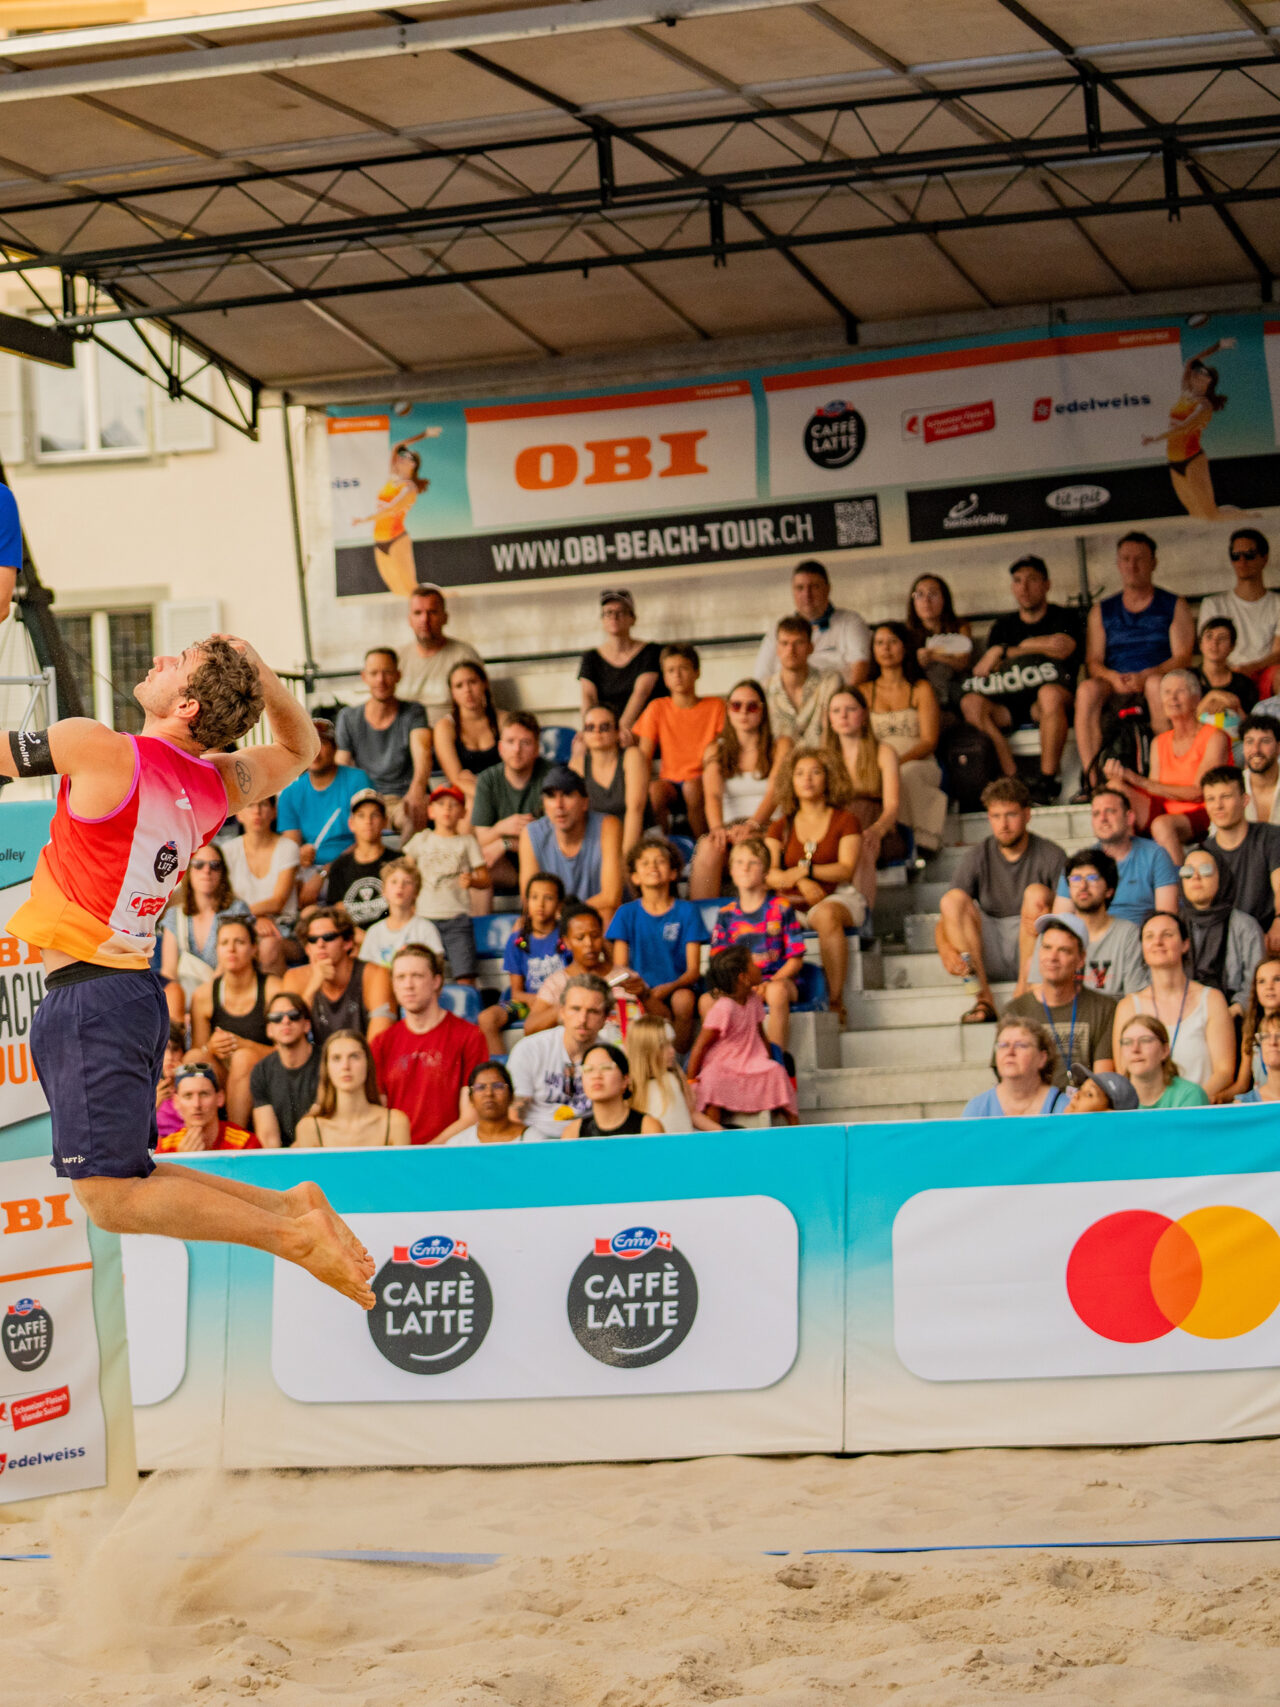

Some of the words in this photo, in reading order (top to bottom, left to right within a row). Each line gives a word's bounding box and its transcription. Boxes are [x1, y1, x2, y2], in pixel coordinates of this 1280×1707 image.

[1055, 394, 1151, 414] edelweiss
[810, 416, 857, 439] CAFFÈ
[812, 434, 858, 454] LATTE
[514, 429, 708, 490] OBI
[491, 513, 814, 573] WWW.OBI-BEACH-TOUR.CH
[412, 1242, 454, 1259] Emmi
[614, 1233, 656, 1249] Emmi
[382, 1271, 475, 1307] CAFFÈ
[583, 1262, 680, 1300] CAFFÈ
[6, 1315, 48, 1338] CAFFÈ
[385, 1308, 475, 1336] LATTE
[586, 1300, 680, 1330] LATTE
[10, 1335, 48, 1354] LATTE
[8, 1446, 86, 1469] edelweiss
